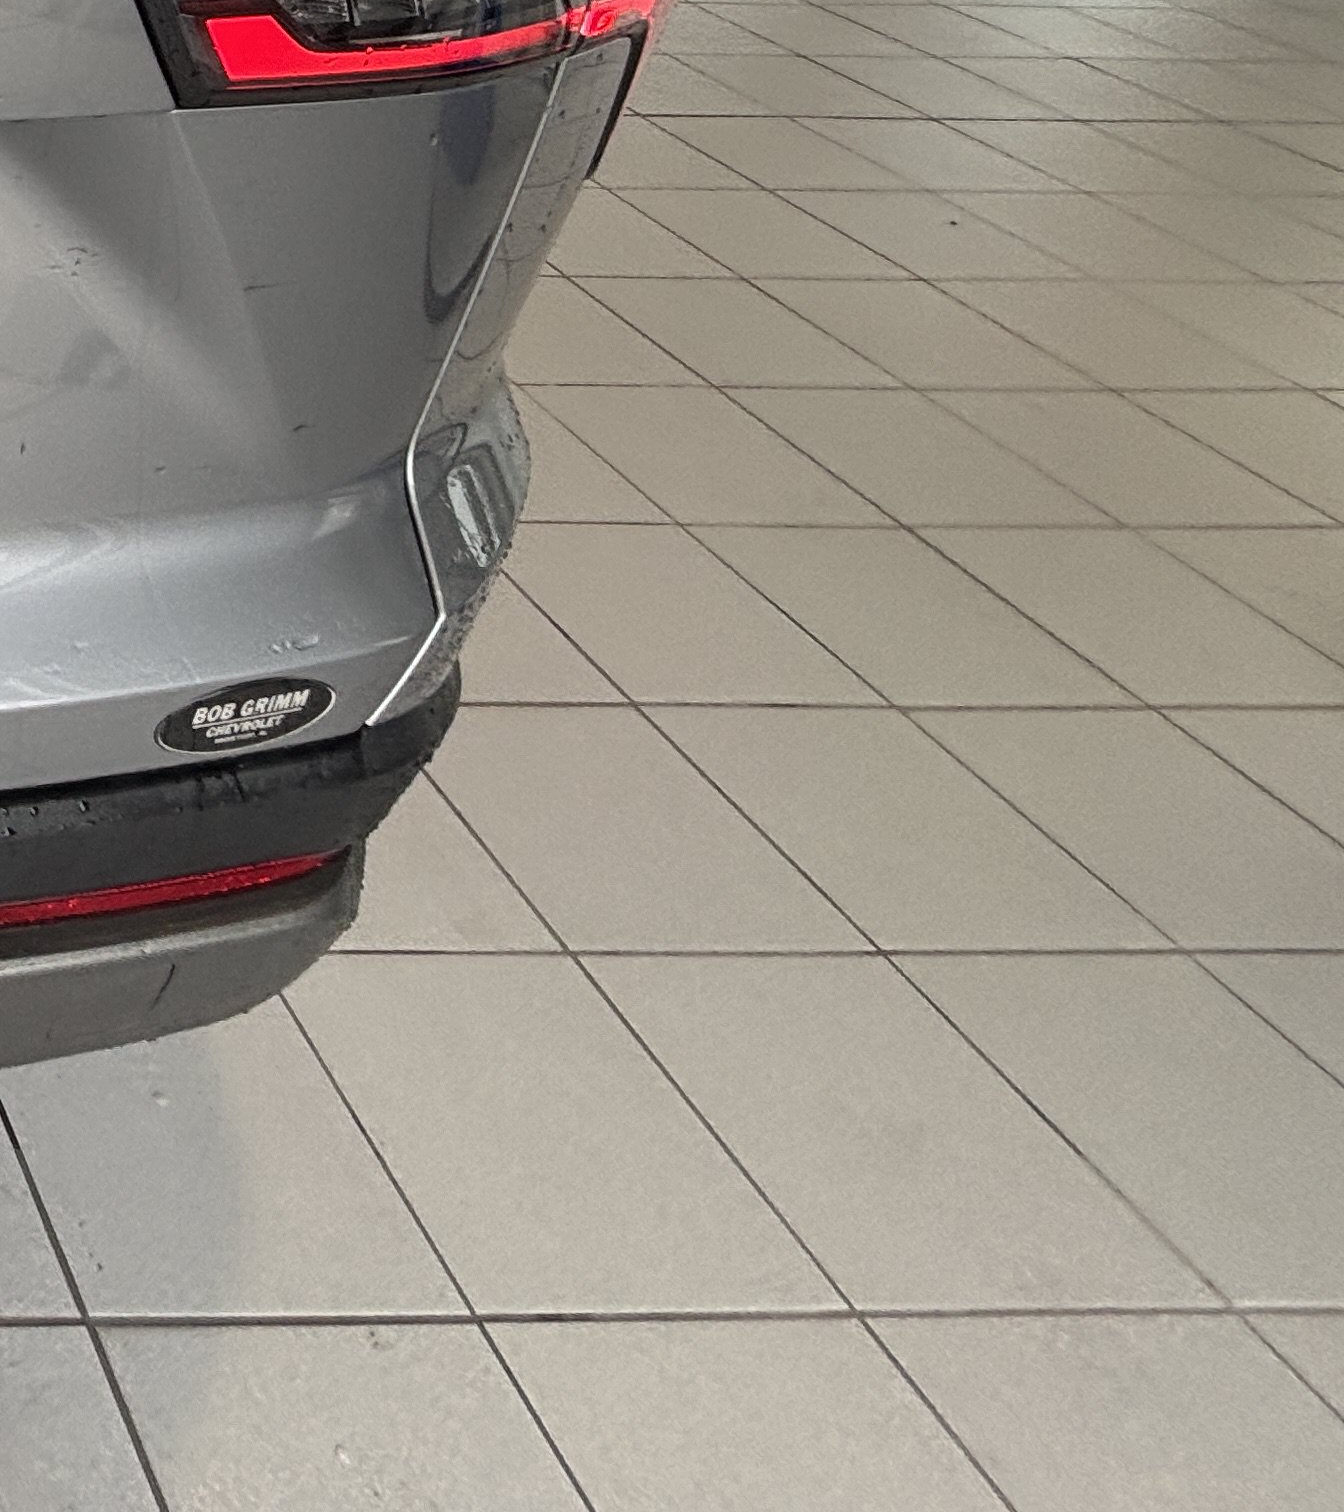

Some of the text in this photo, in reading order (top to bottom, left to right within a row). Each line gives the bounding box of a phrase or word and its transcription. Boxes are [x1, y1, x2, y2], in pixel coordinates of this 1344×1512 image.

[192, 689, 310, 725] BOB GRIMM
[206, 714, 287, 738] CHEVROLET
